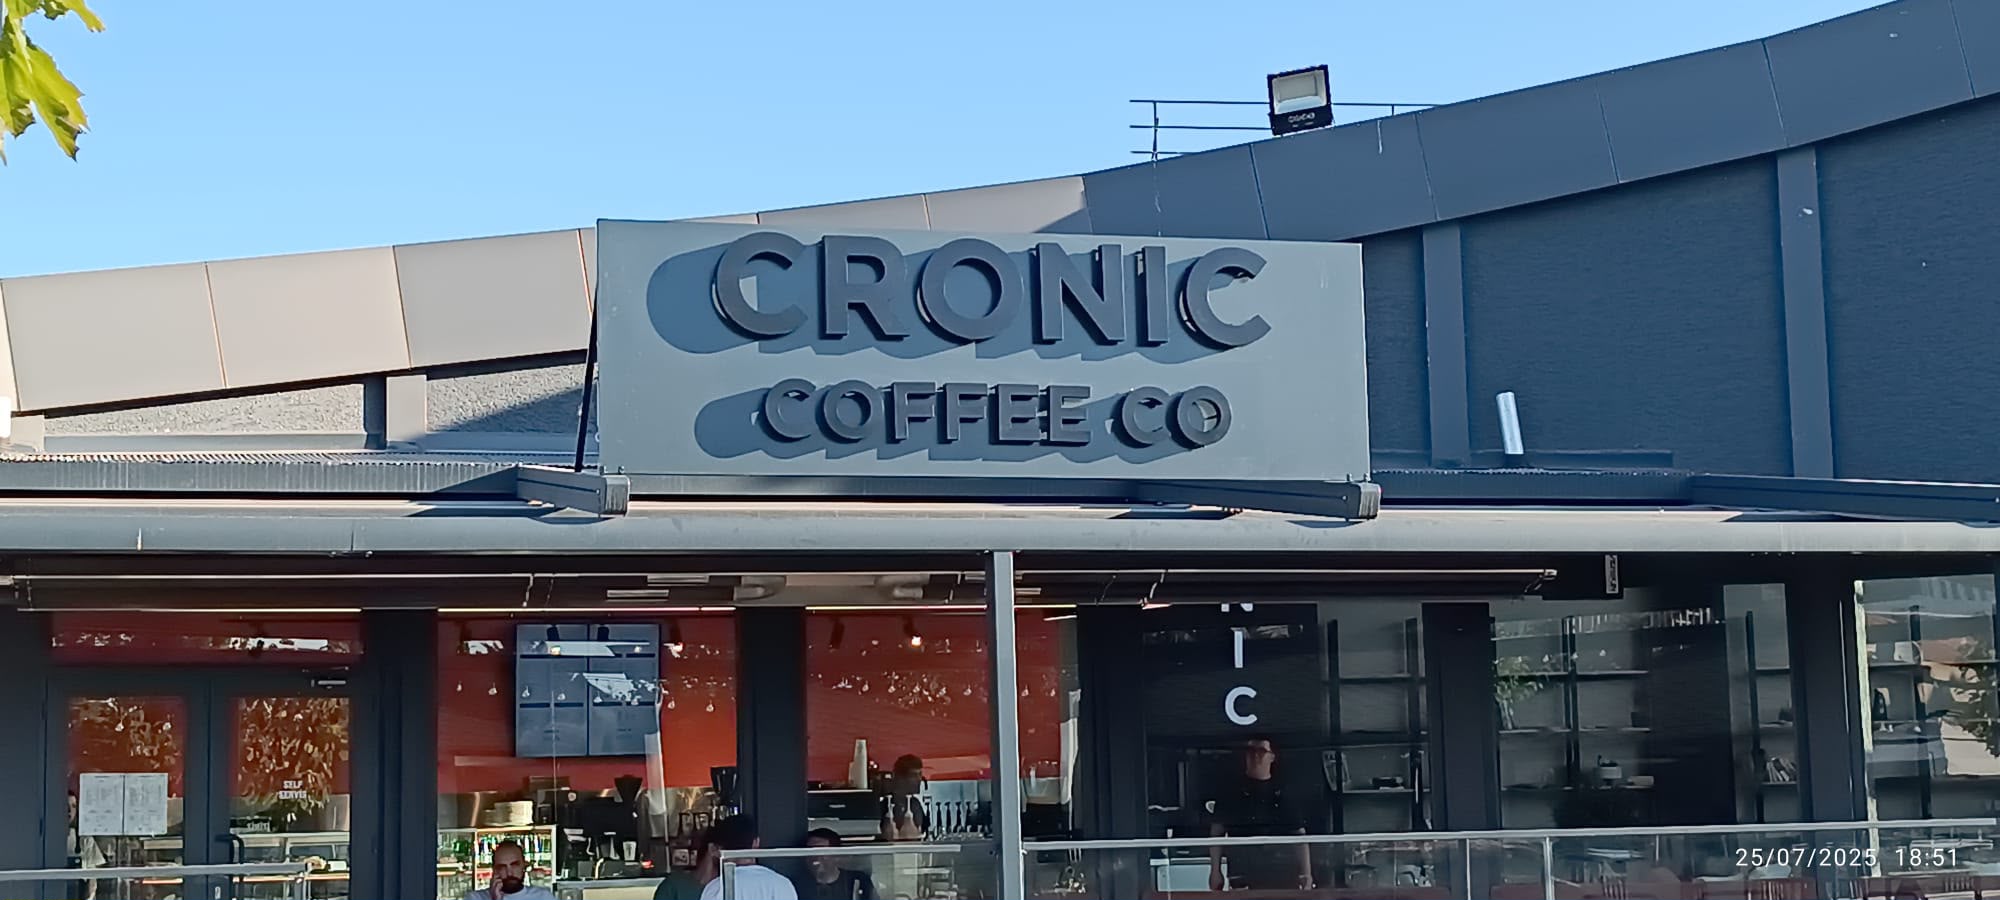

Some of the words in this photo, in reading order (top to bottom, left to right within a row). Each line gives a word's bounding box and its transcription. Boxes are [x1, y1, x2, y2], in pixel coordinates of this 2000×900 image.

[713, 231, 1272, 348] CRONIC
[760, 378, 1091, 446] COFFEE
[1115, 385, 1232, 449] CO
[283, 780, 304, 789] SELF
